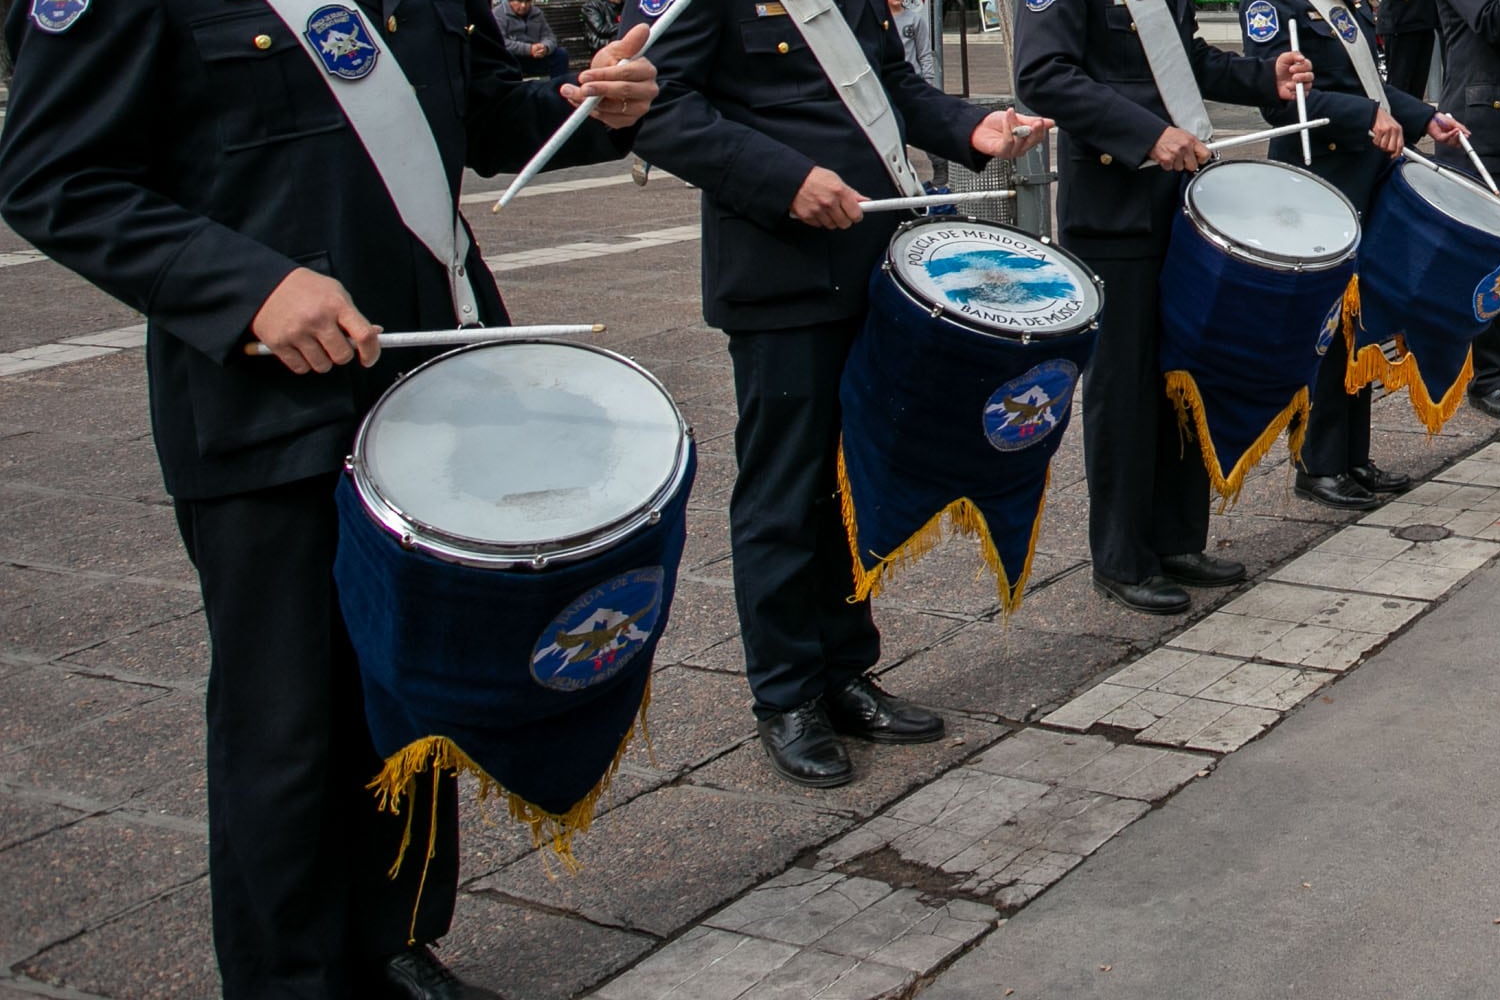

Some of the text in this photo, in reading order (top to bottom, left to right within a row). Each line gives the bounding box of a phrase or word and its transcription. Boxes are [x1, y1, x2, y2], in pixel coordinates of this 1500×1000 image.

[909, 229, 1047, 266] POLICÍA DE MENDOZA
[960, 298, 1083, 327] BANDA DE MÚSICA
